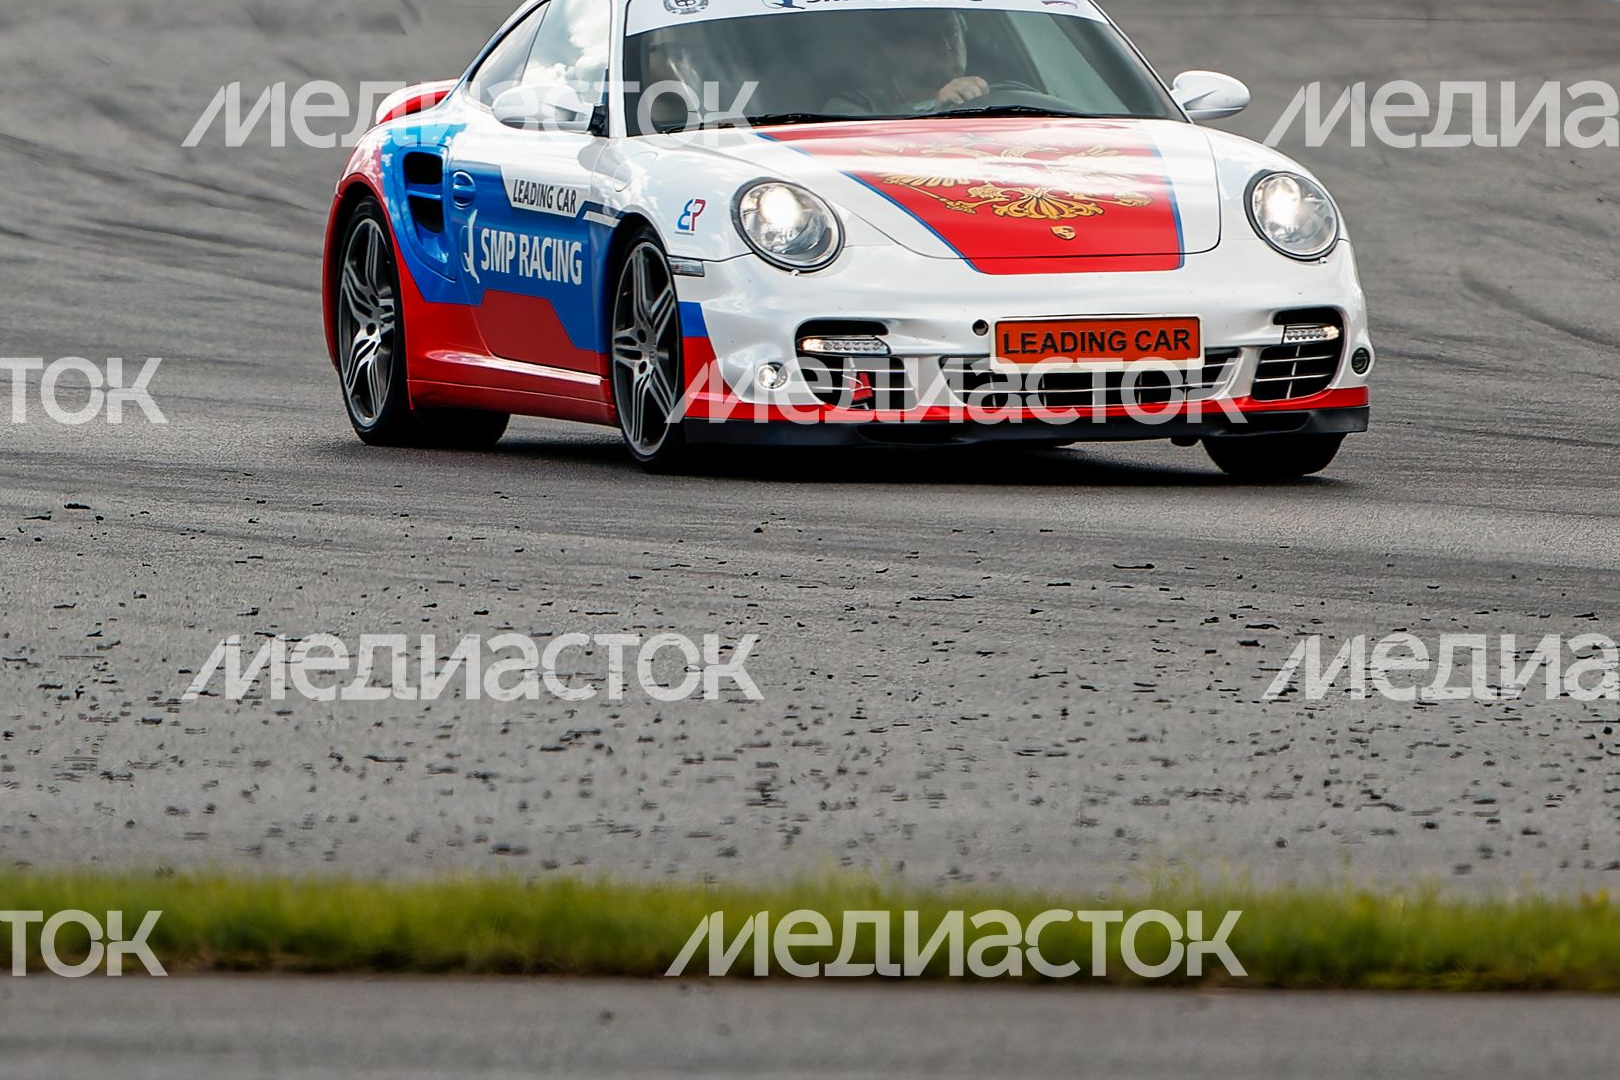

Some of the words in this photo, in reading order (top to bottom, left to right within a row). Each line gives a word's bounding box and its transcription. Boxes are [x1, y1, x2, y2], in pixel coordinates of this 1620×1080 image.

[512, 179, 554, 209] LEADING
[556, 187, 577, 214] CAR
[481, 228, 516, 274] SMP
[519, 234, 582, 285] RACING
[1003, 330, 1127, 354] LEADING
[1134, 329, 1191, 352] CAR
